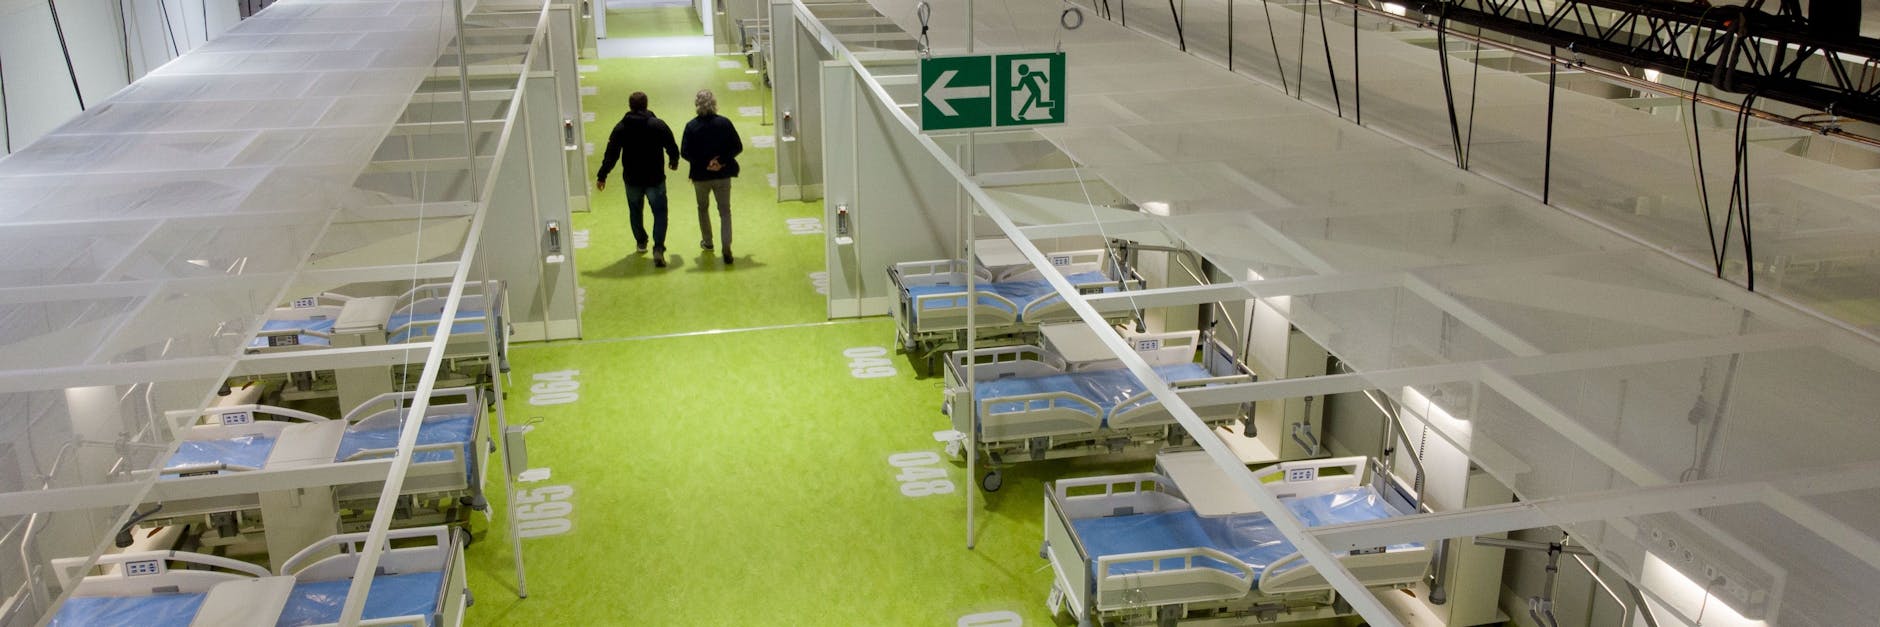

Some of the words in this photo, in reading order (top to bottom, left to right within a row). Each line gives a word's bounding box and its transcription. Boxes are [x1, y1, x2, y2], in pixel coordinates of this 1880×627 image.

[843, 346, 897, 379] 049
[529, 369, 580, 406] 064
[888, 451, 956, 497] 048
[516, 484, 574, 538] 065
